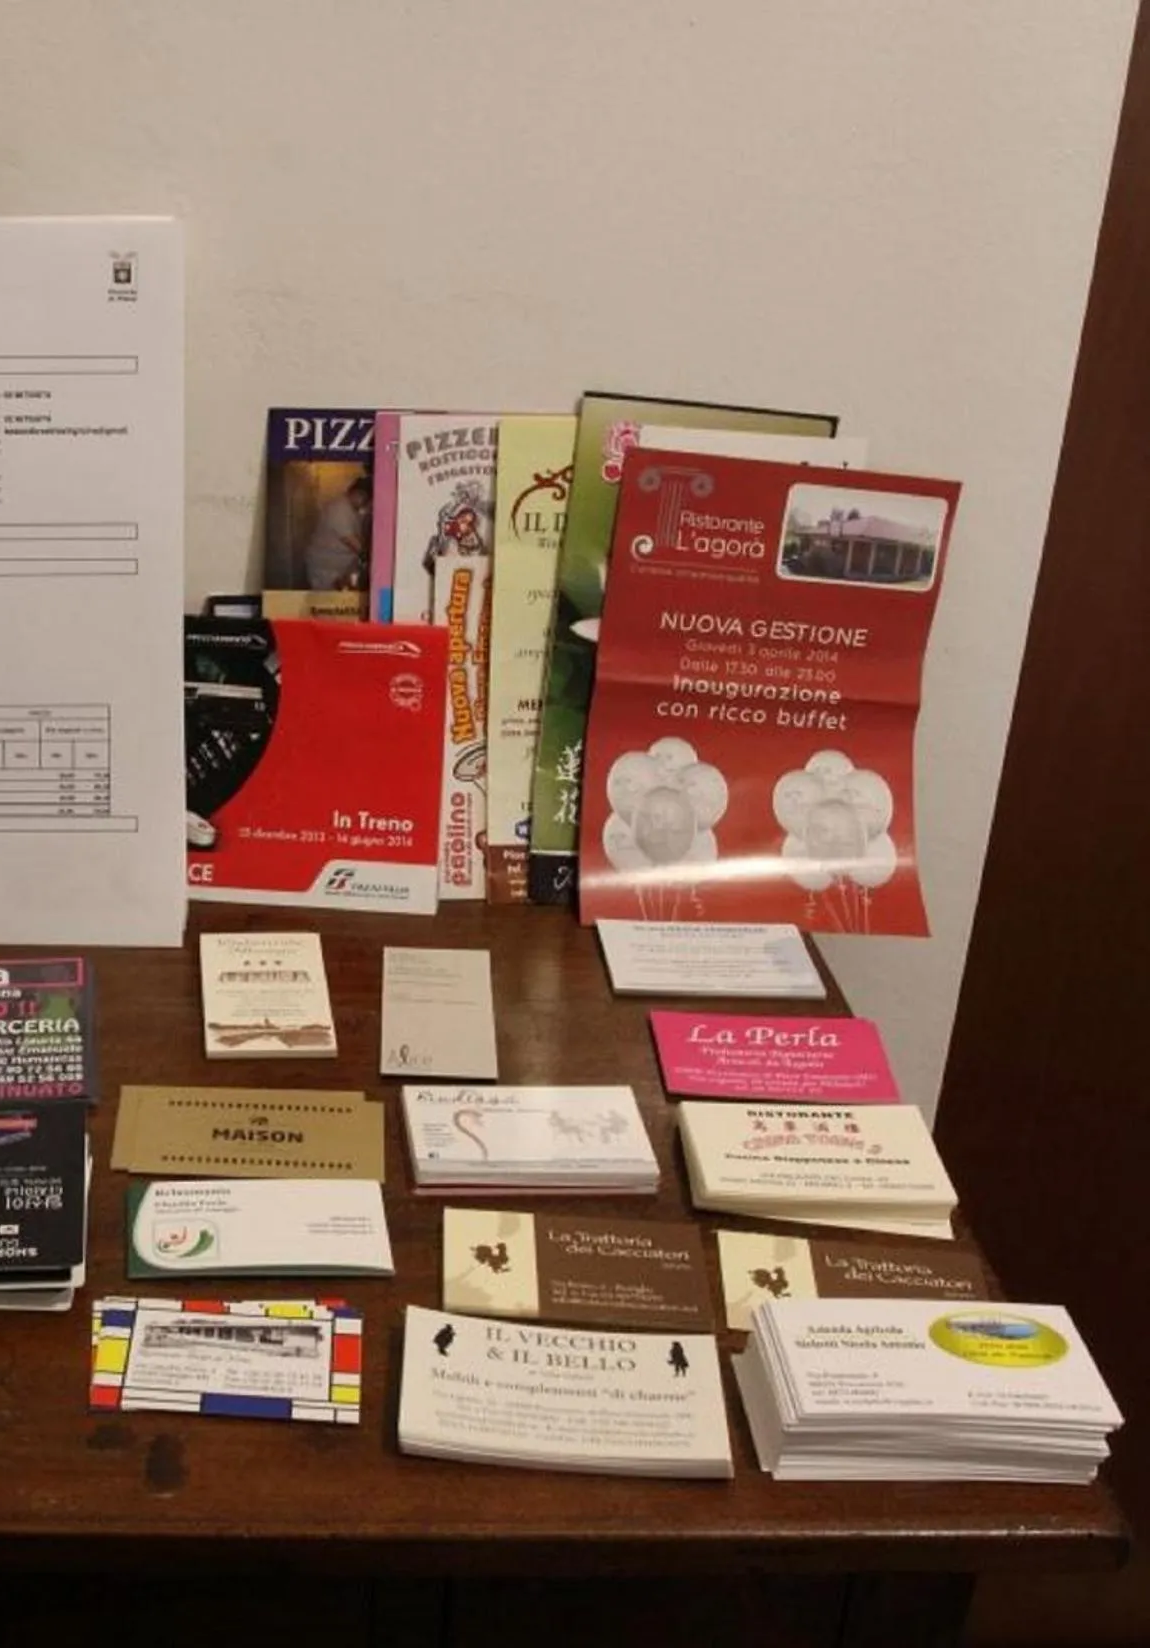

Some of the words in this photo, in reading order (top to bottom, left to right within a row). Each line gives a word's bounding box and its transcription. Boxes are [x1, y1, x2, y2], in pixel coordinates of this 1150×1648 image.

[680, 510, 766, 535] Ristorante
[447, 567, 473, 668] apertura
[659, 612, 744, 636] NUOVA
[750, 620, 868, 647] GESTIONE
[758, 645, 801, 661] aprile
[680, 657, 719, 674] Dalle
[764, 664, 792, 679] alle
[673, 674, 842, 704] Inaugurazione
[448, 667, 478, 745] Nuova
[656, 701, 699, 718] con
[708, 703, 767, 724] ricco
[776, 704, 848, 731] buffet
[333, 809, 352, 829] In
[358, 810, 415, 833] Treno
[187, 863, 214, 882] CE
[687, 1024, 737, 1044] La
[744, 1025, 842, 1048] Perla
[211, 1126, 305, 1144] MAISON
[547, 1229, 573, 1242] La
[574, 1230, 653, 1248] Trattoria
[825, 1253, 849, 1268] La
[852, 1257, 933, 1275] Trattoria
[485, 1326, 511, 1342] IL
[517, 1329, 637, 1353] VECCHIO
[486, 1347, 504, 1361] &
[512, 1349, 539, 1366] IL
[546, 1353, 637, 1372] BELLO
